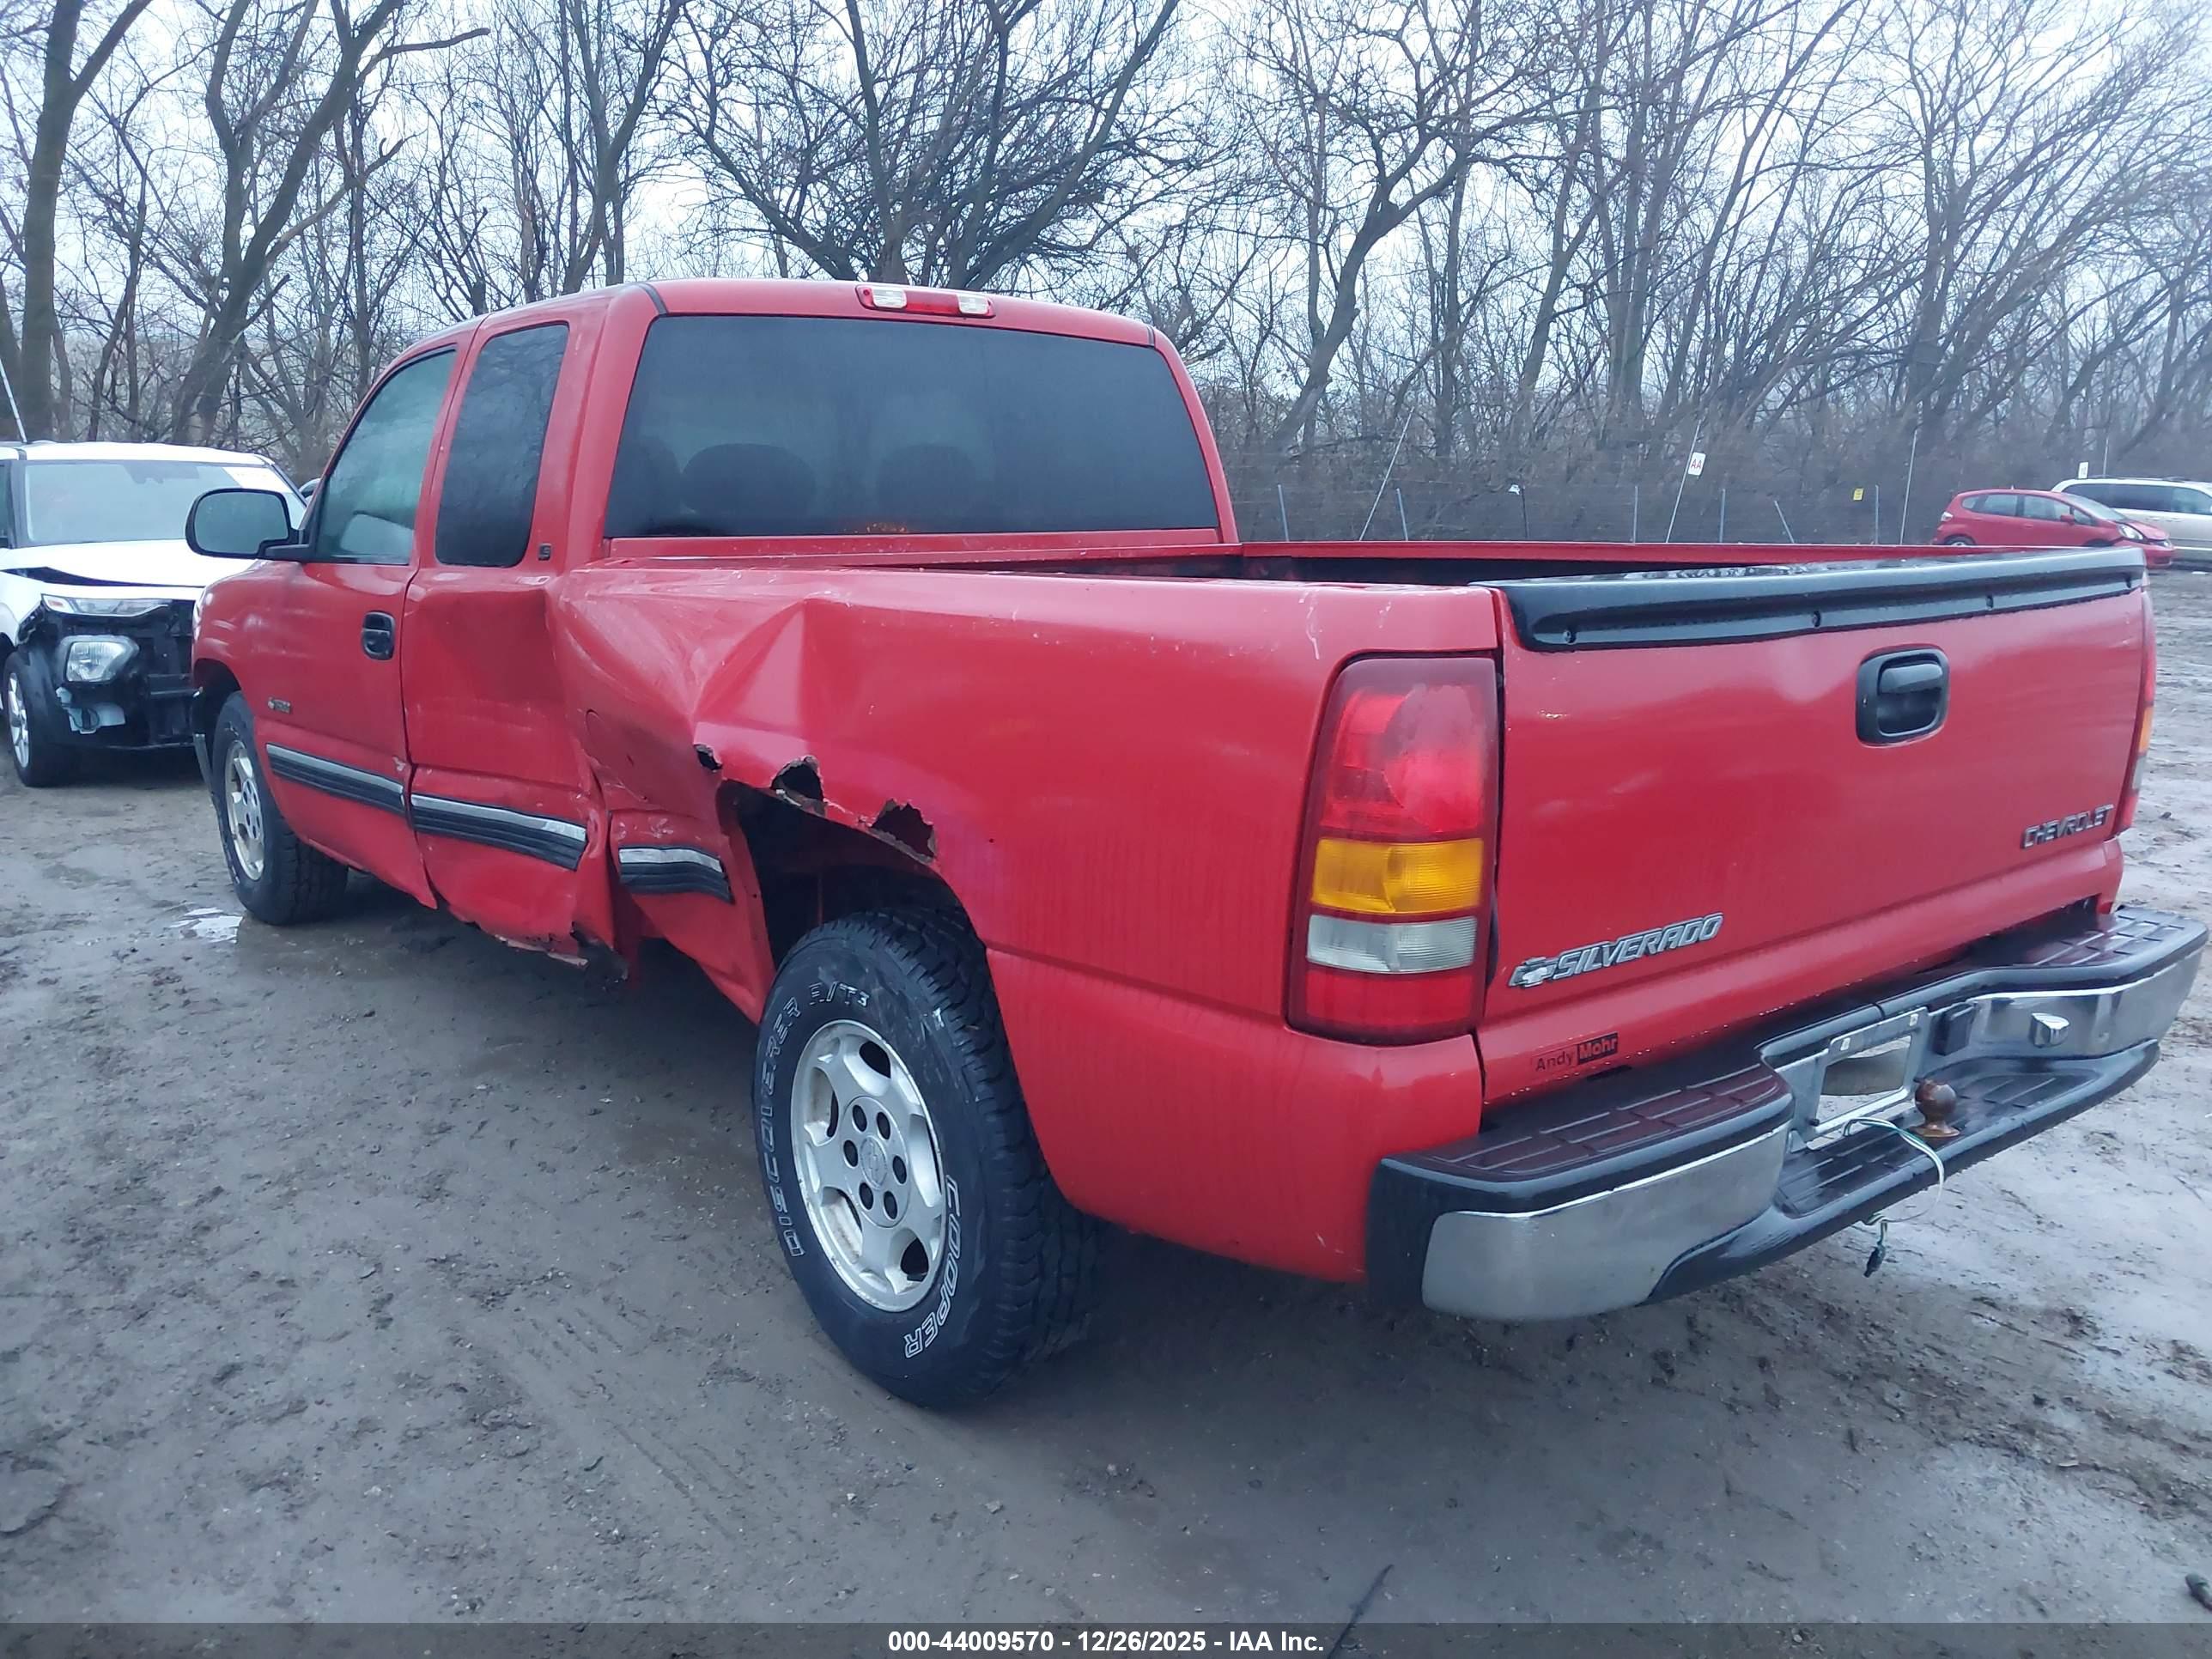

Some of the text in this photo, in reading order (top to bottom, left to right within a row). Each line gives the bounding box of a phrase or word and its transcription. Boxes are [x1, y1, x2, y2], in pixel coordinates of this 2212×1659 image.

[2021, 804, 2114, 848] CHEVROLET
[1553, 913, 1723, 980] SILVERADO
[1535, 1038, 1617, 1072] Andy Mohr
[903, 1174, 961, 1358] COOPER
